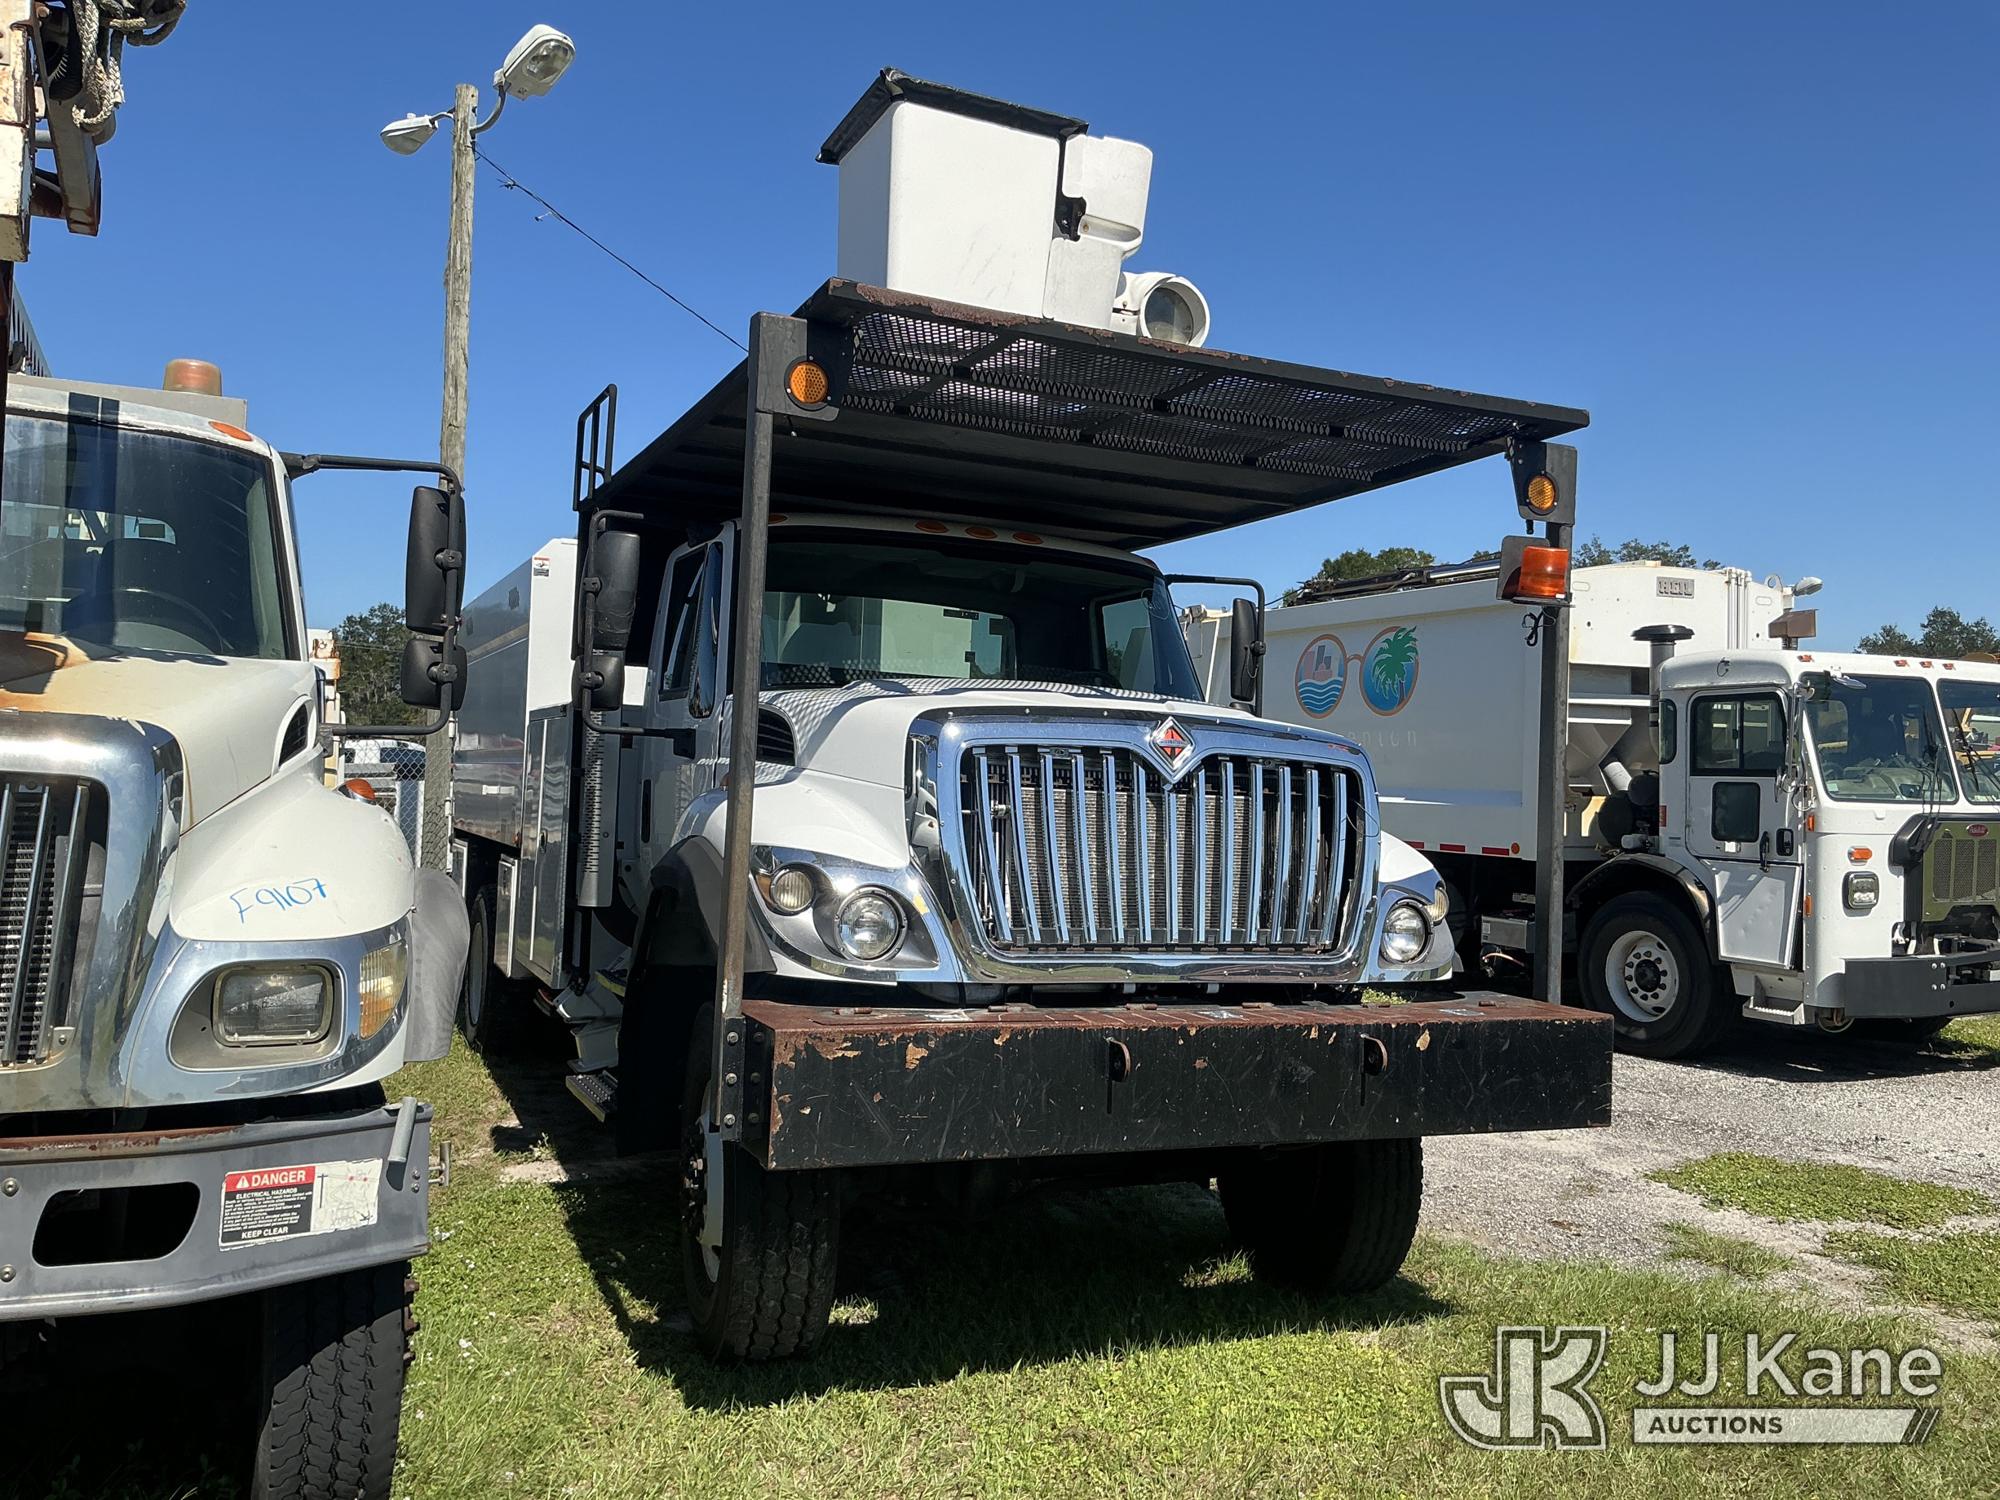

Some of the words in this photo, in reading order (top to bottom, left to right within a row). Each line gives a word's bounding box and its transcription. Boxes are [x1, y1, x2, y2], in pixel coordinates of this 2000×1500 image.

[251, 1170, 306, 1187] DANGER
[236, 1191, 270, 1199] ELECTRICAL
[241, 1229, 262, 1240] KEEP
[263, 1226, 289, 1237] CLEAR
